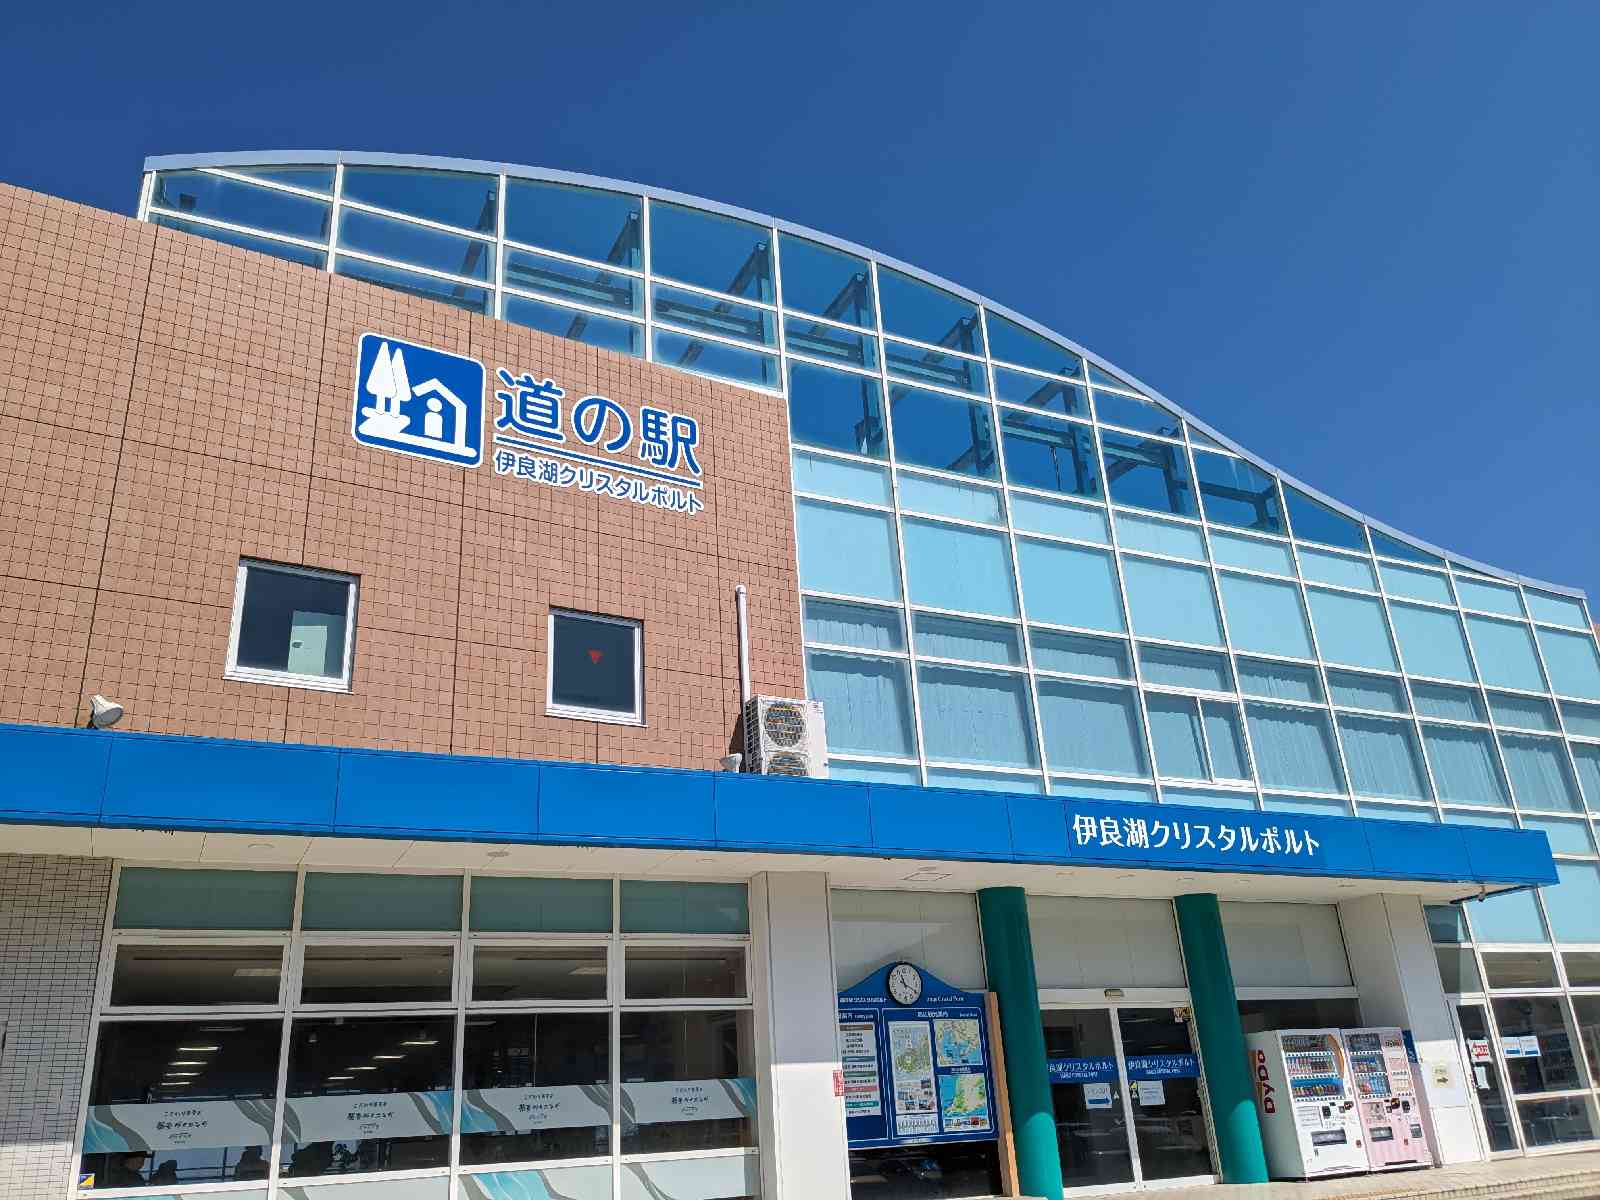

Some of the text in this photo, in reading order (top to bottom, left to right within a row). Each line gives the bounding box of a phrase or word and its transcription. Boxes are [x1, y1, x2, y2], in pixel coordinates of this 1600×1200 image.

[495, 367, 702, 475] 道の駅
[495, 451, 703, 513] 伊良湖クリスタルポルト
[1072, 814, 1320, 856] 伊良湖クリスタルポルト
